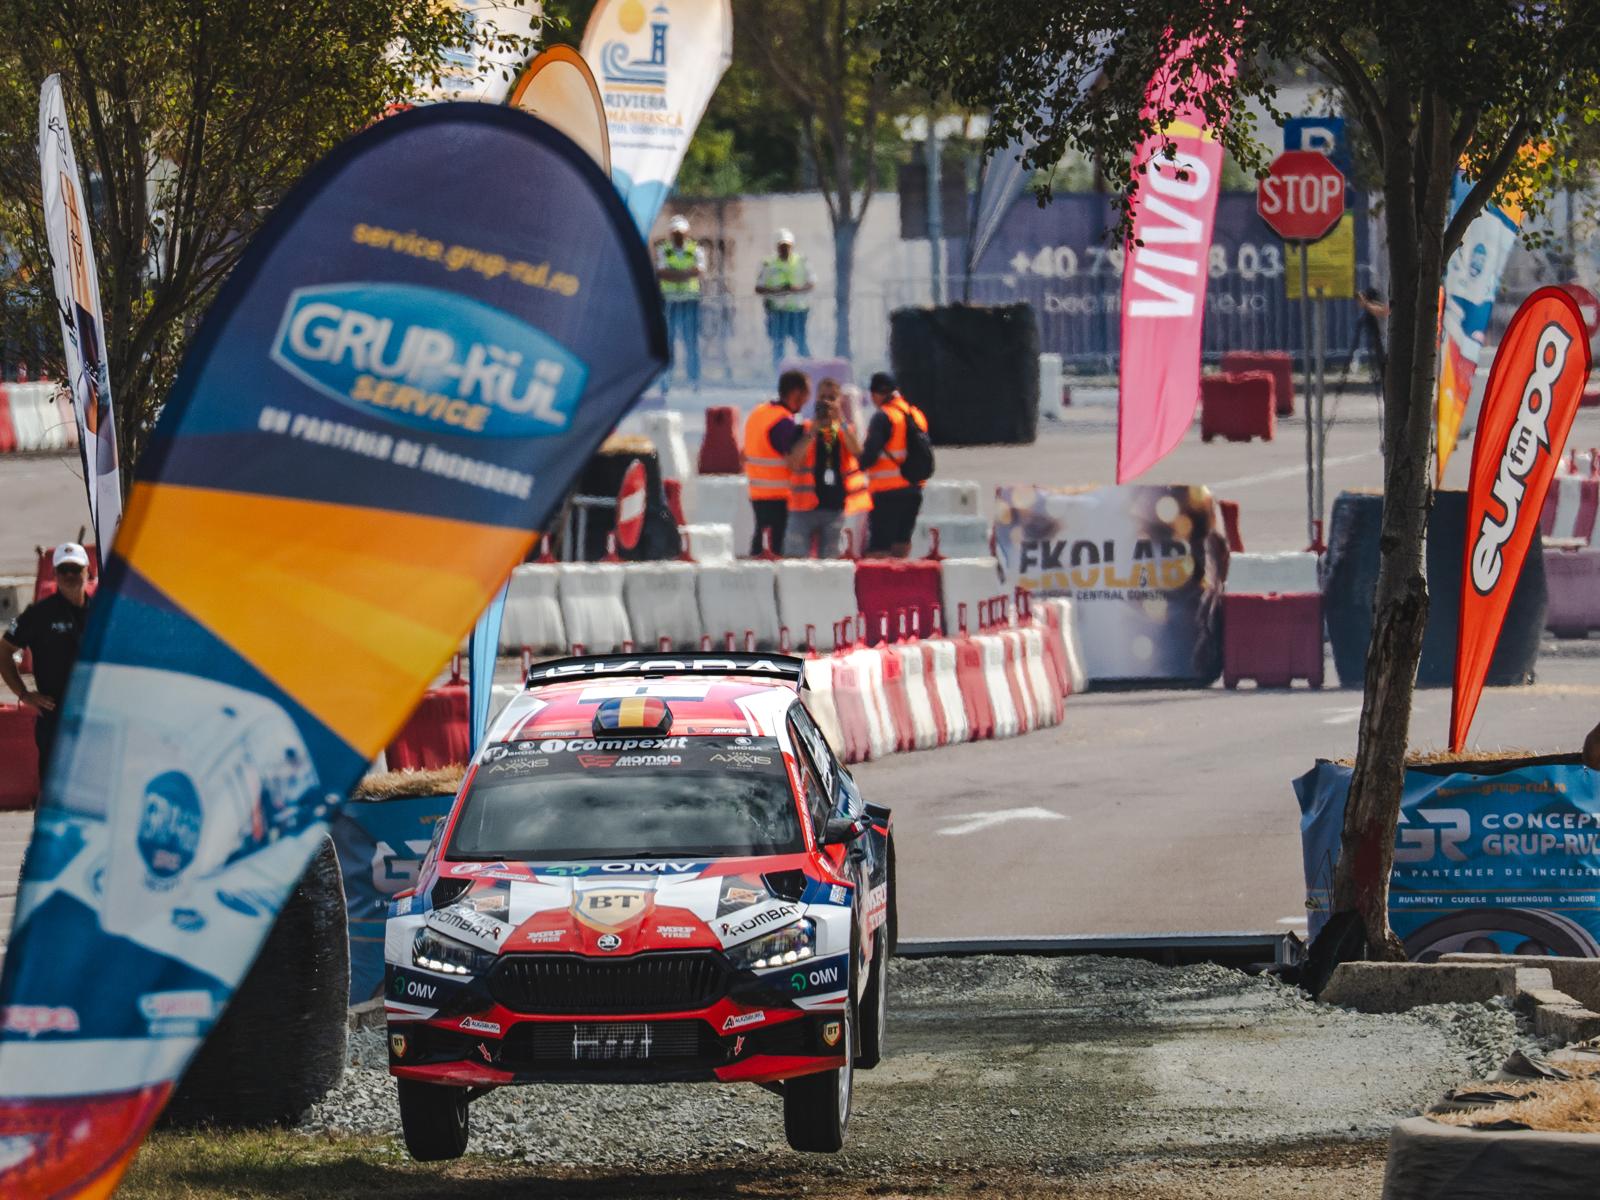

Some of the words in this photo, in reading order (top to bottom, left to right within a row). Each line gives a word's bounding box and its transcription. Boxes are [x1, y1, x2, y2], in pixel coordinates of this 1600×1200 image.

[1261, 174, 1342, 215] STOP
[1127, 152, 1211, 318] VIVO
[1017, 538, 1194, 590] EKOLAB
[566, 737, 689, 752] Compexit
[601, 862, 696, 872] OMV
[1411, 868, 1495, 878] PARTENER
[1505, 867, 1523, 877] DE
[589, 895, 640, 909] BT
[1451, 896, 1487, 904] CURELE
[429, 911, 494, 939] ROMBAT
[729, 904, 799, 937] ROMBAT
[809, 966, 839, 986] OMV
[407, 981, 438, 999] OMV
[826, 1026, 839, 1036] BT
